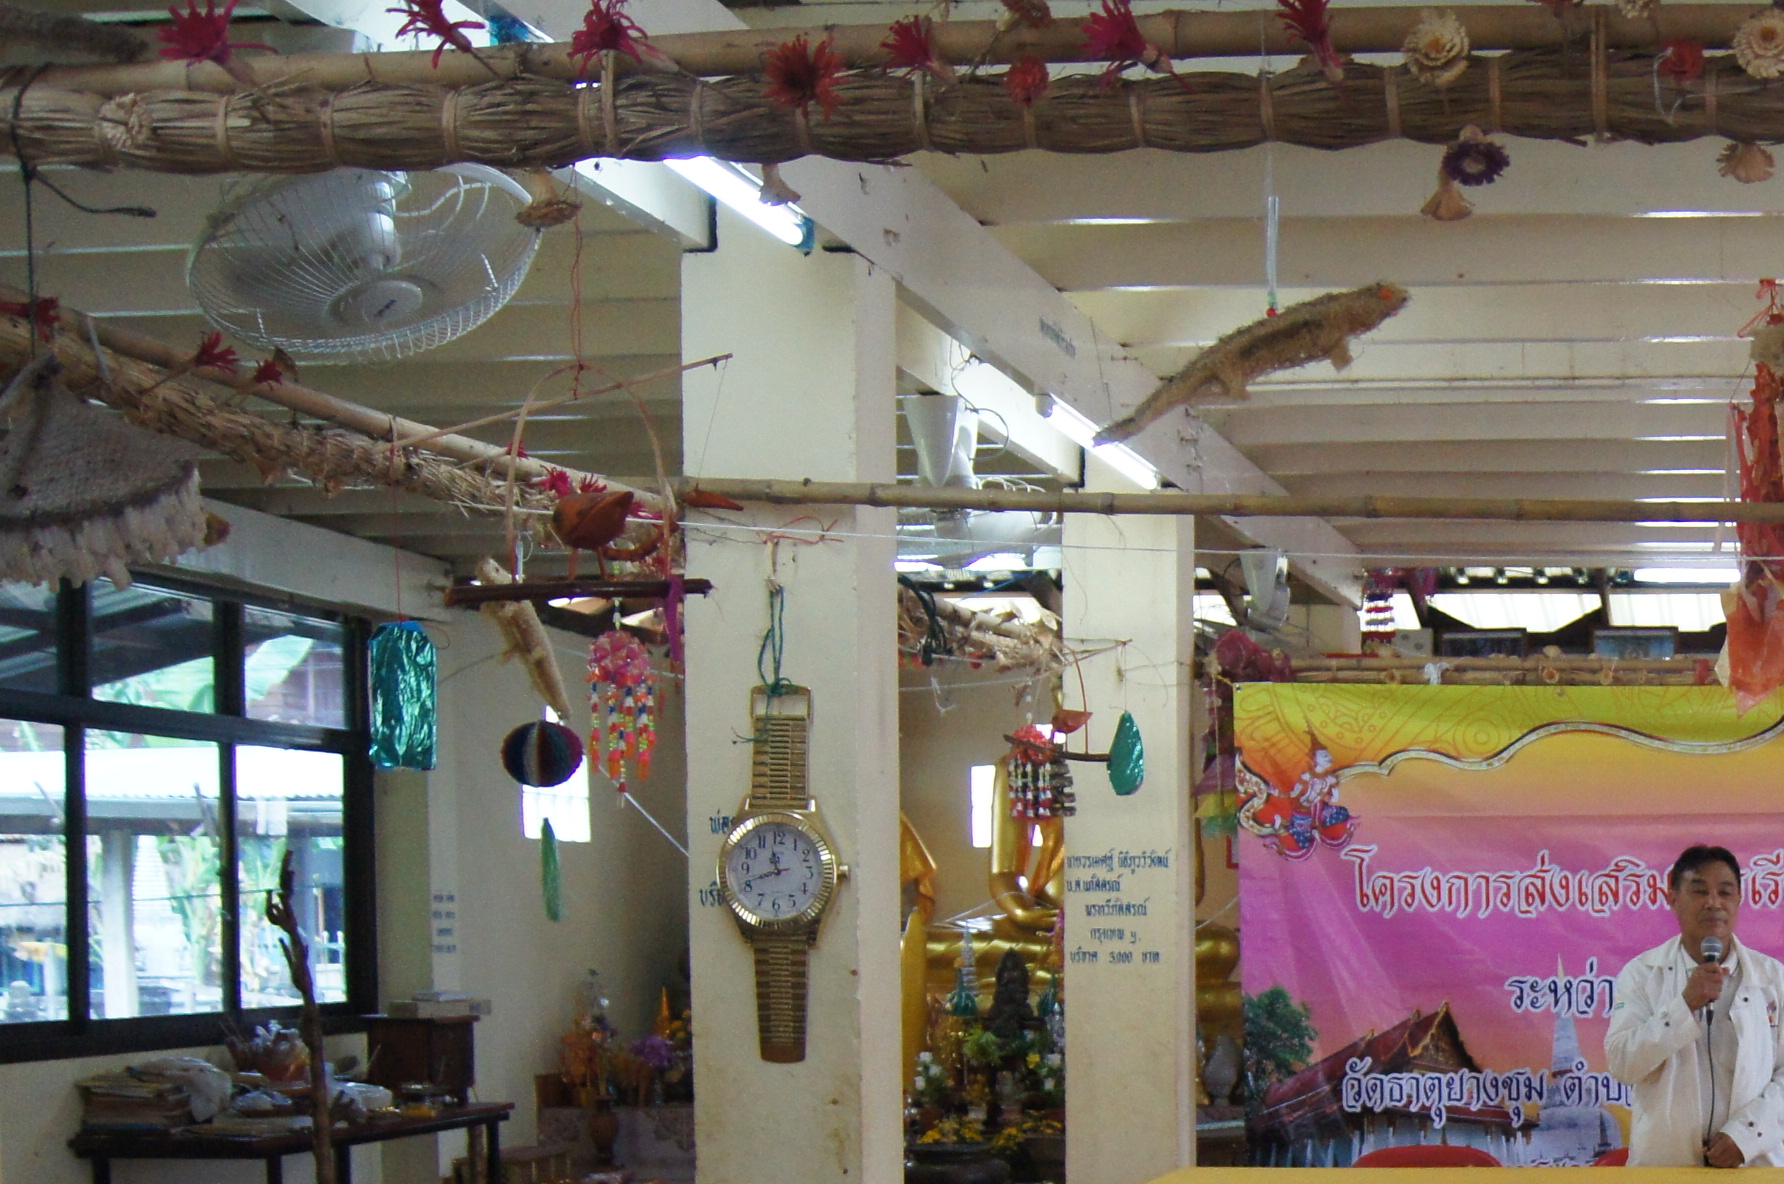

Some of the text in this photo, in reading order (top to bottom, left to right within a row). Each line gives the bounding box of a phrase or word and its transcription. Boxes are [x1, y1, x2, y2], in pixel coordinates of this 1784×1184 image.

[757, 835, 766, 849] 11
[774, 831, 786, 845] 12
[793, 838, 797, 851] 1
[745, 847, 757, 860] 10
[802, 849, 810, 862] 2
[741, 862, 750, 875] 9
[806, 866, 814, 879] 3
[744, 880, 752, 893] 8
[802, 882, 808, 895] 4
[758, 893, 764, 906] 7
[772, 898, 780, 912] 6
[789, 894, 796, 908] 5
[1507, 958, 1616, 1015] ระหว่า
[1342, 1056, 1546, 1128] วัดธาตุยางชุม
